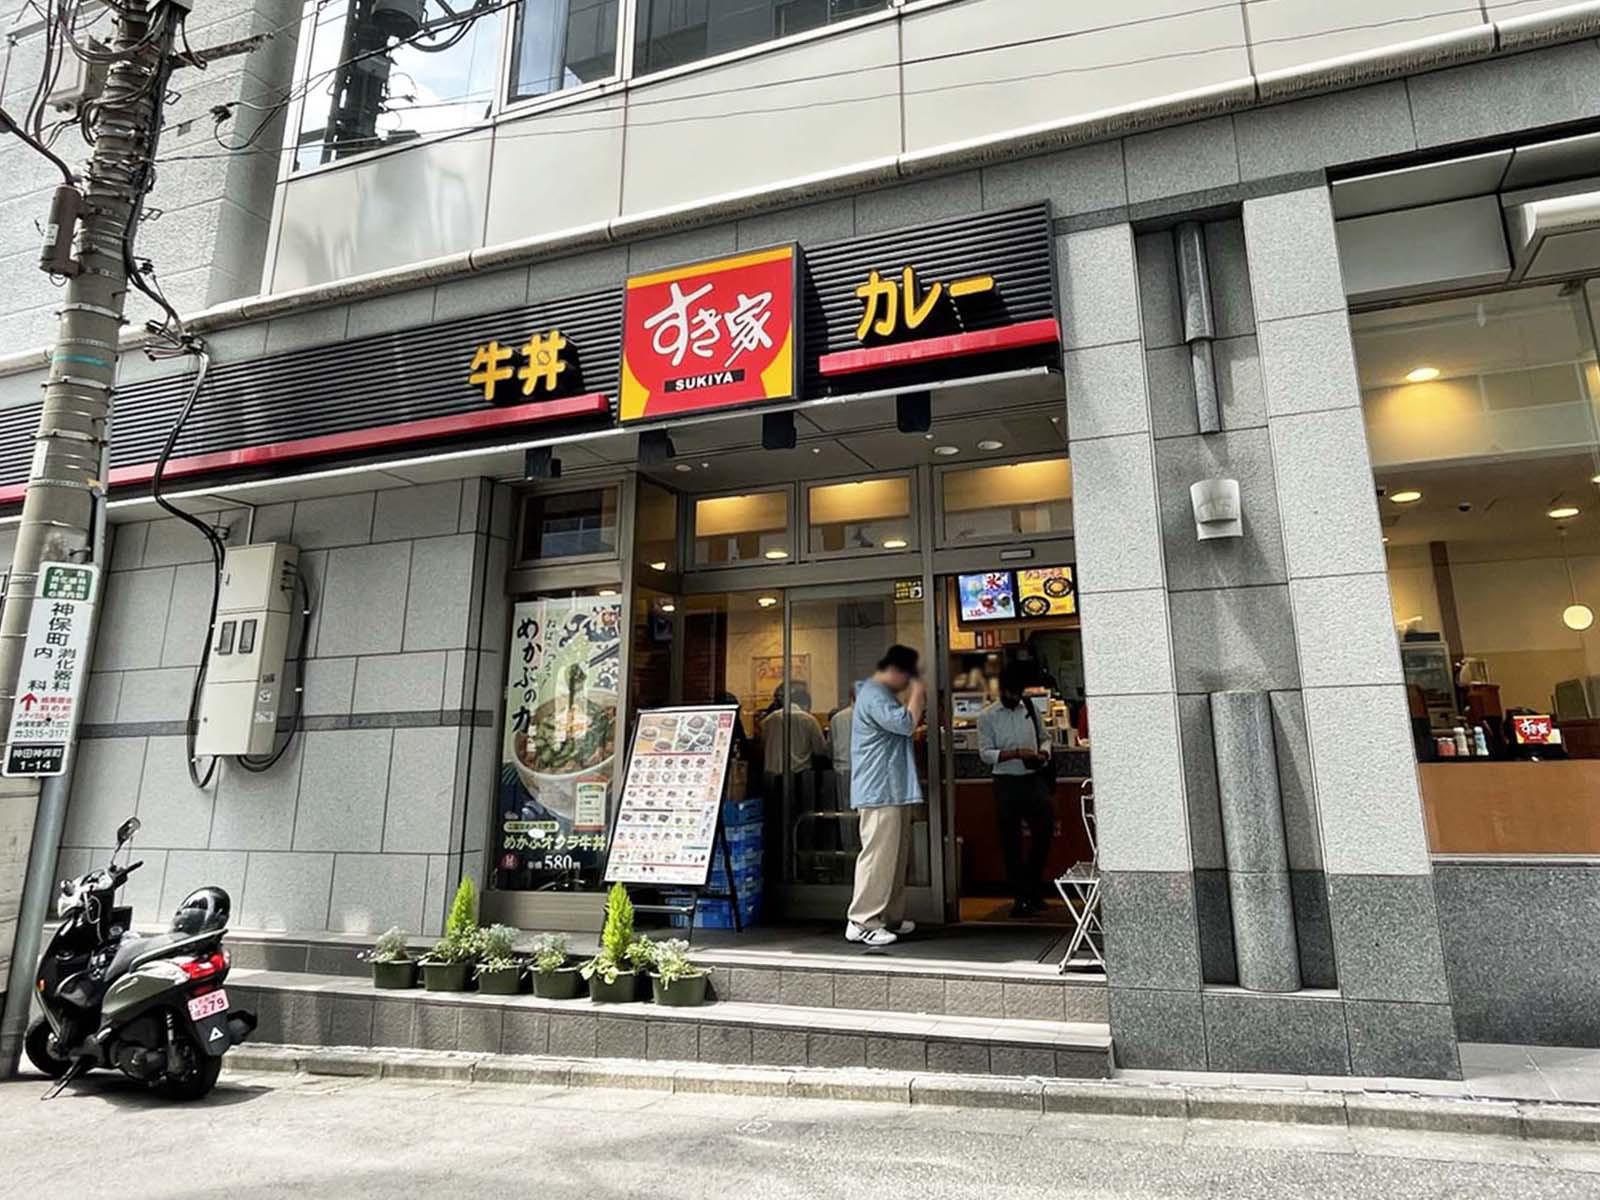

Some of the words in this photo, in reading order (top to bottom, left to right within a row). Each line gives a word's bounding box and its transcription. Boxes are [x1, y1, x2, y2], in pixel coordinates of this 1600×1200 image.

[644, 283, 772, 368] すき家
[856, 266, 994, 341] カレー
[469, 329, 567, 401] 牛丼
[675, 371, 734, 391] SUKIYA
[46, 603, 75, 647] 神保町
[52, 648, 77, 692] 消化器科
[512, 618, 542, 733] めかぶの力
[20, 760, 51, 770] 1-14
